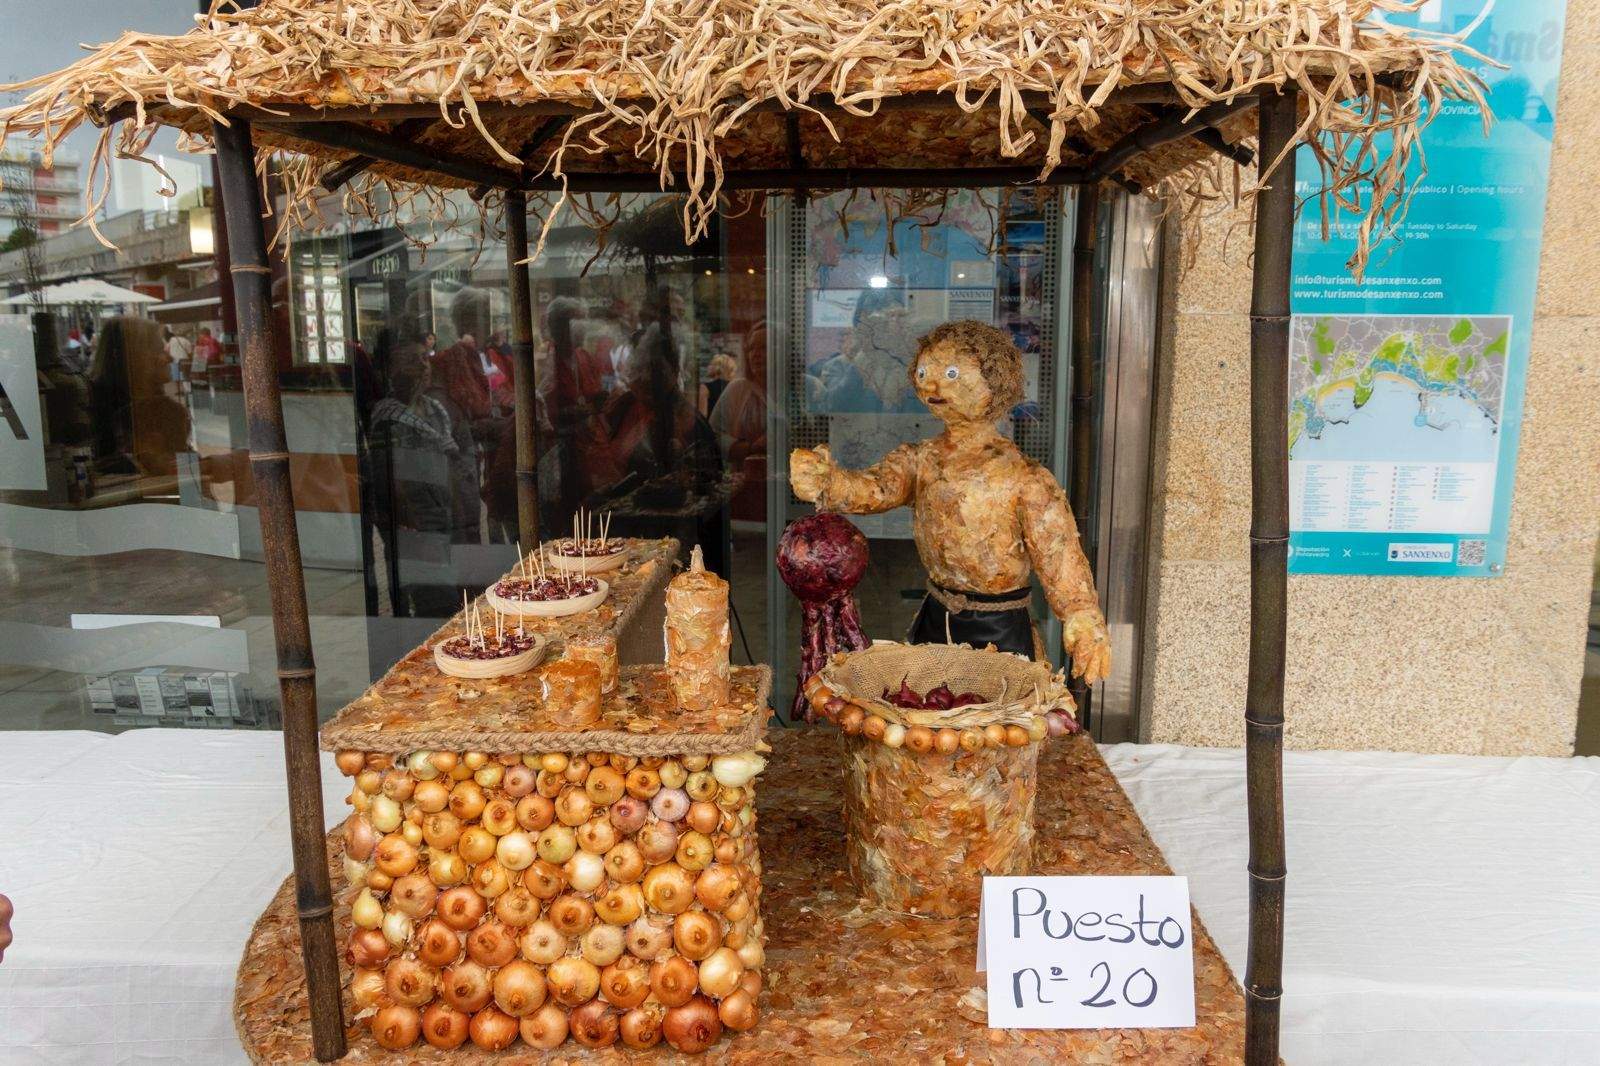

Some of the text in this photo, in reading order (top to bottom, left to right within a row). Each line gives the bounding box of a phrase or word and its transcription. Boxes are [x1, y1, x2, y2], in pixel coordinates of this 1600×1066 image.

[1458, 184, 1495, 196] Opening
[1294, 289, 1443, 299] www.turismodesanxenxo.com
[1402, 549, 1450, 560] SANXENXO
[1011, 887, 1185, 949] Puesto
[1079, 961, 1158, 1008] 20
